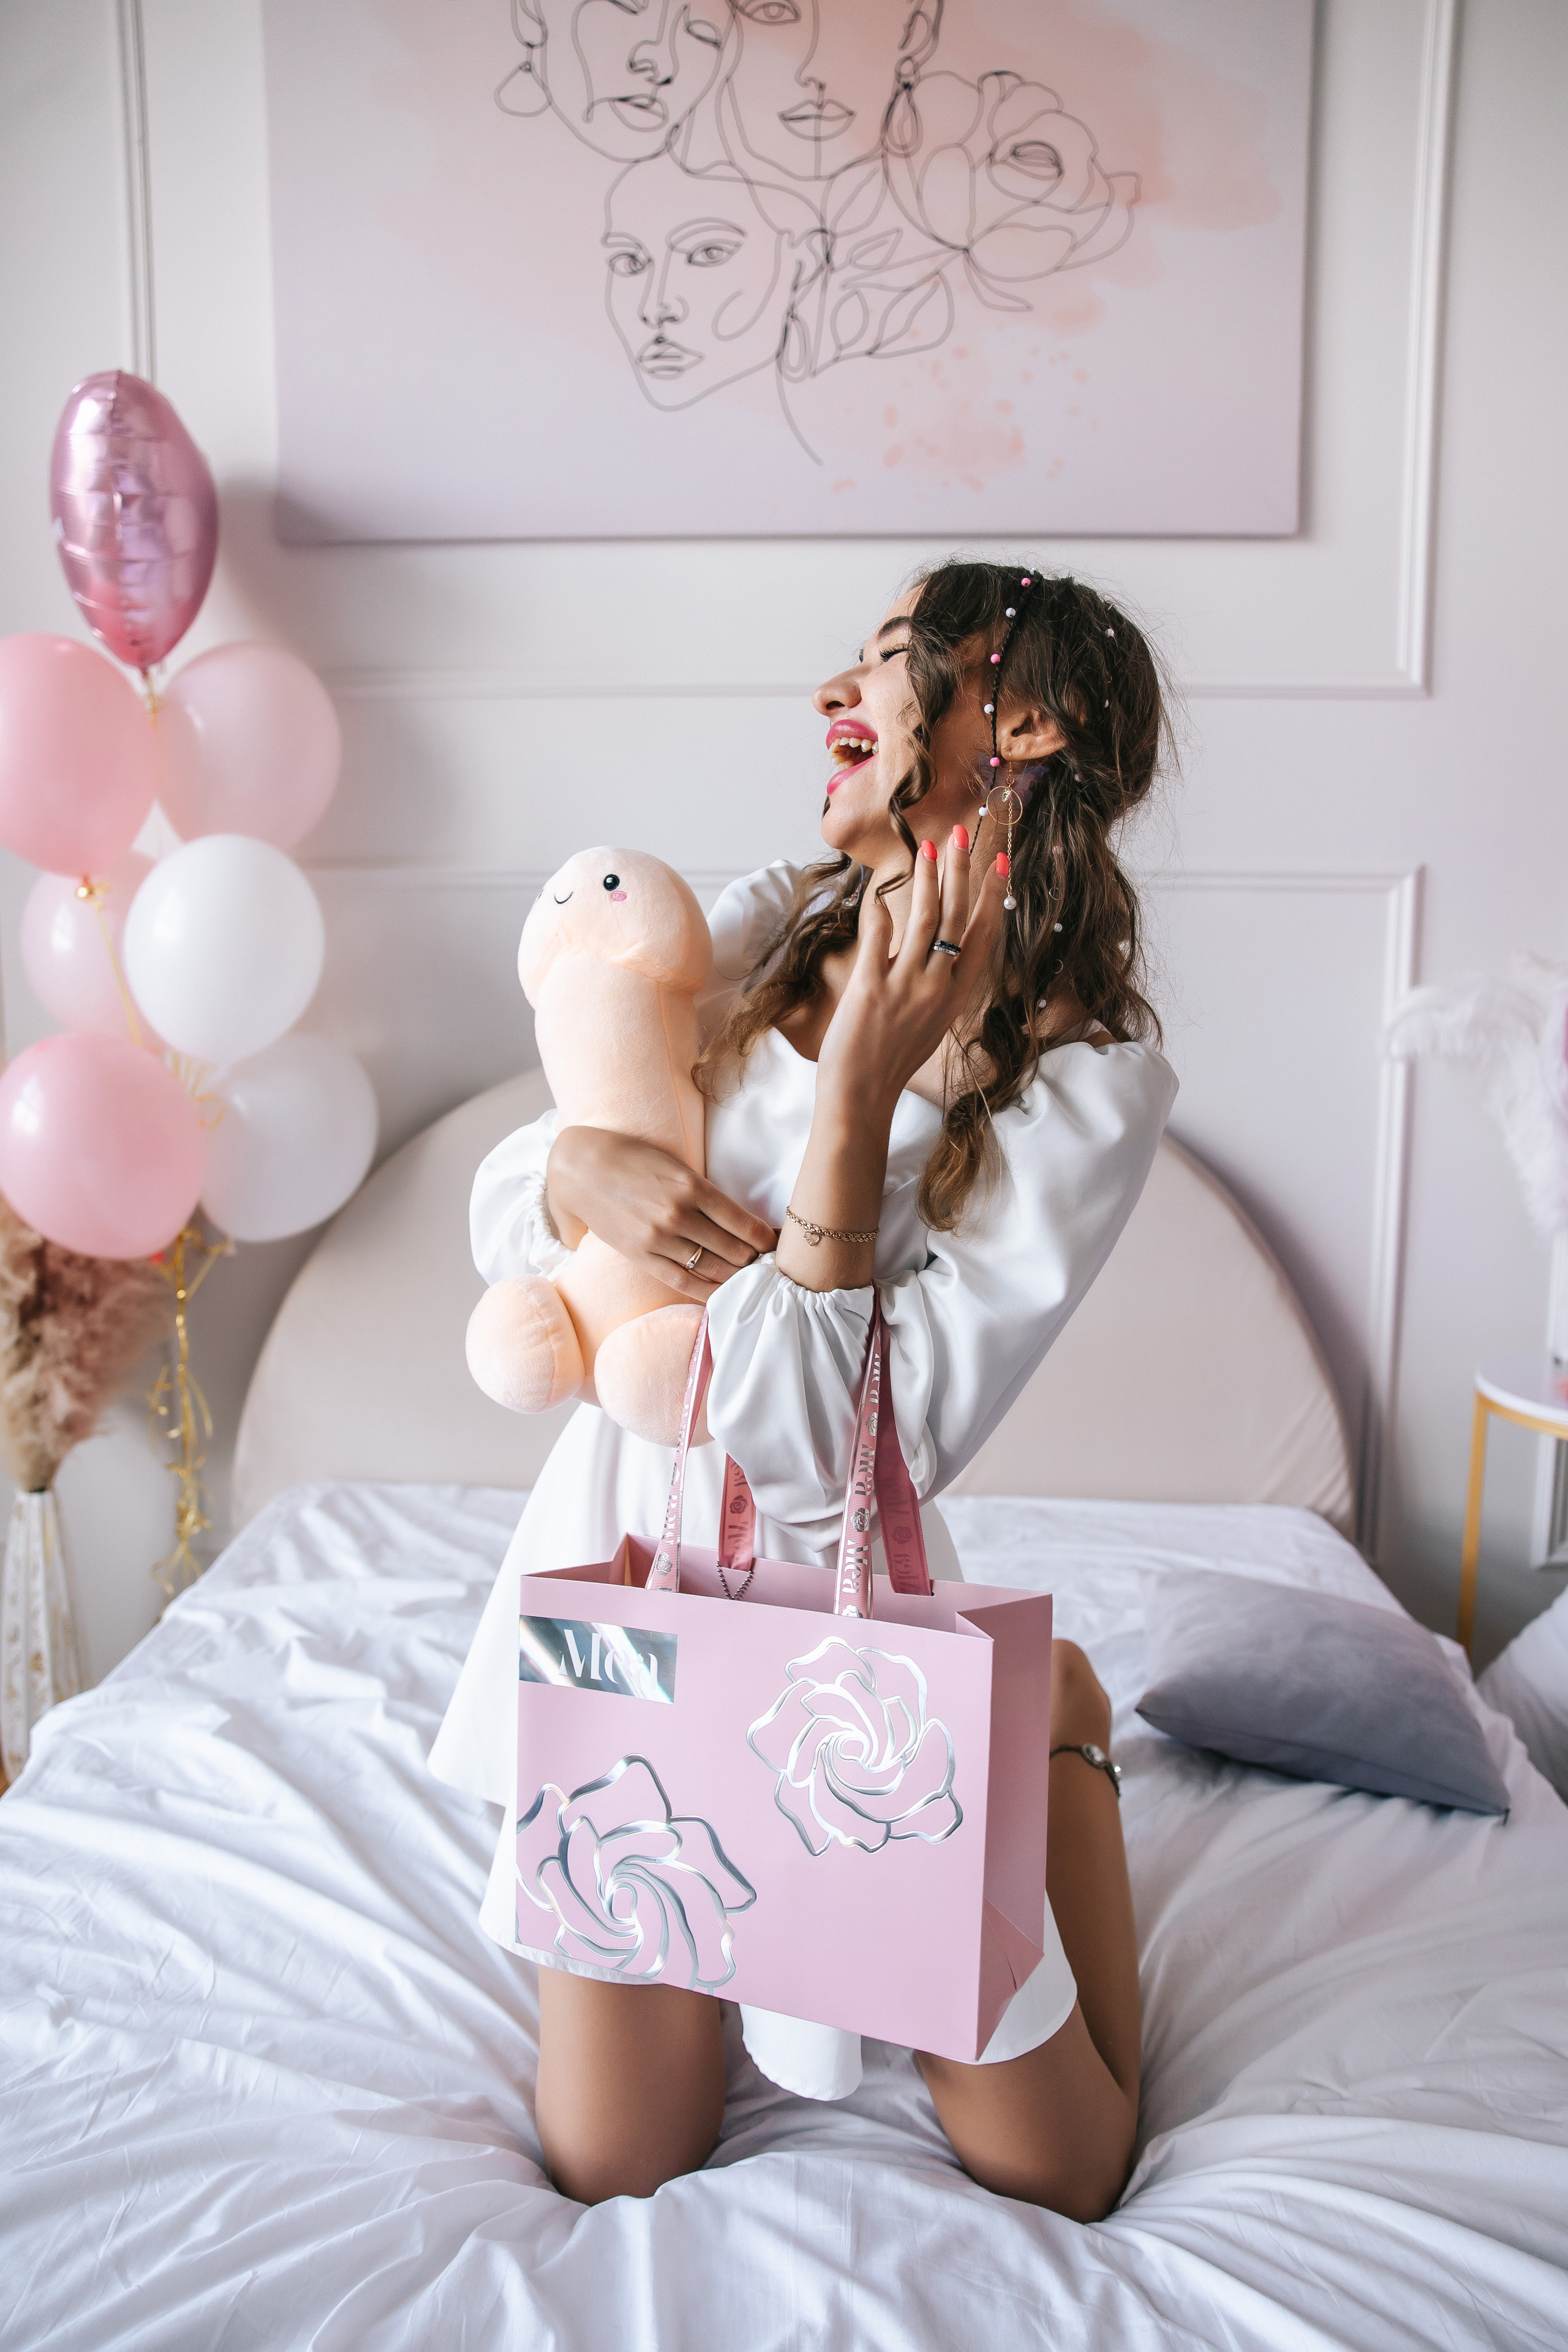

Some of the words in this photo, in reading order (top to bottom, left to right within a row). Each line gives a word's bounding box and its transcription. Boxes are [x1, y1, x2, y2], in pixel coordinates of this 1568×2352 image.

[854, 1443, 876, 1496] Mea
[842, 1539, 869, 1594] Mea
[558, 1629, 658, 1691] Mea
